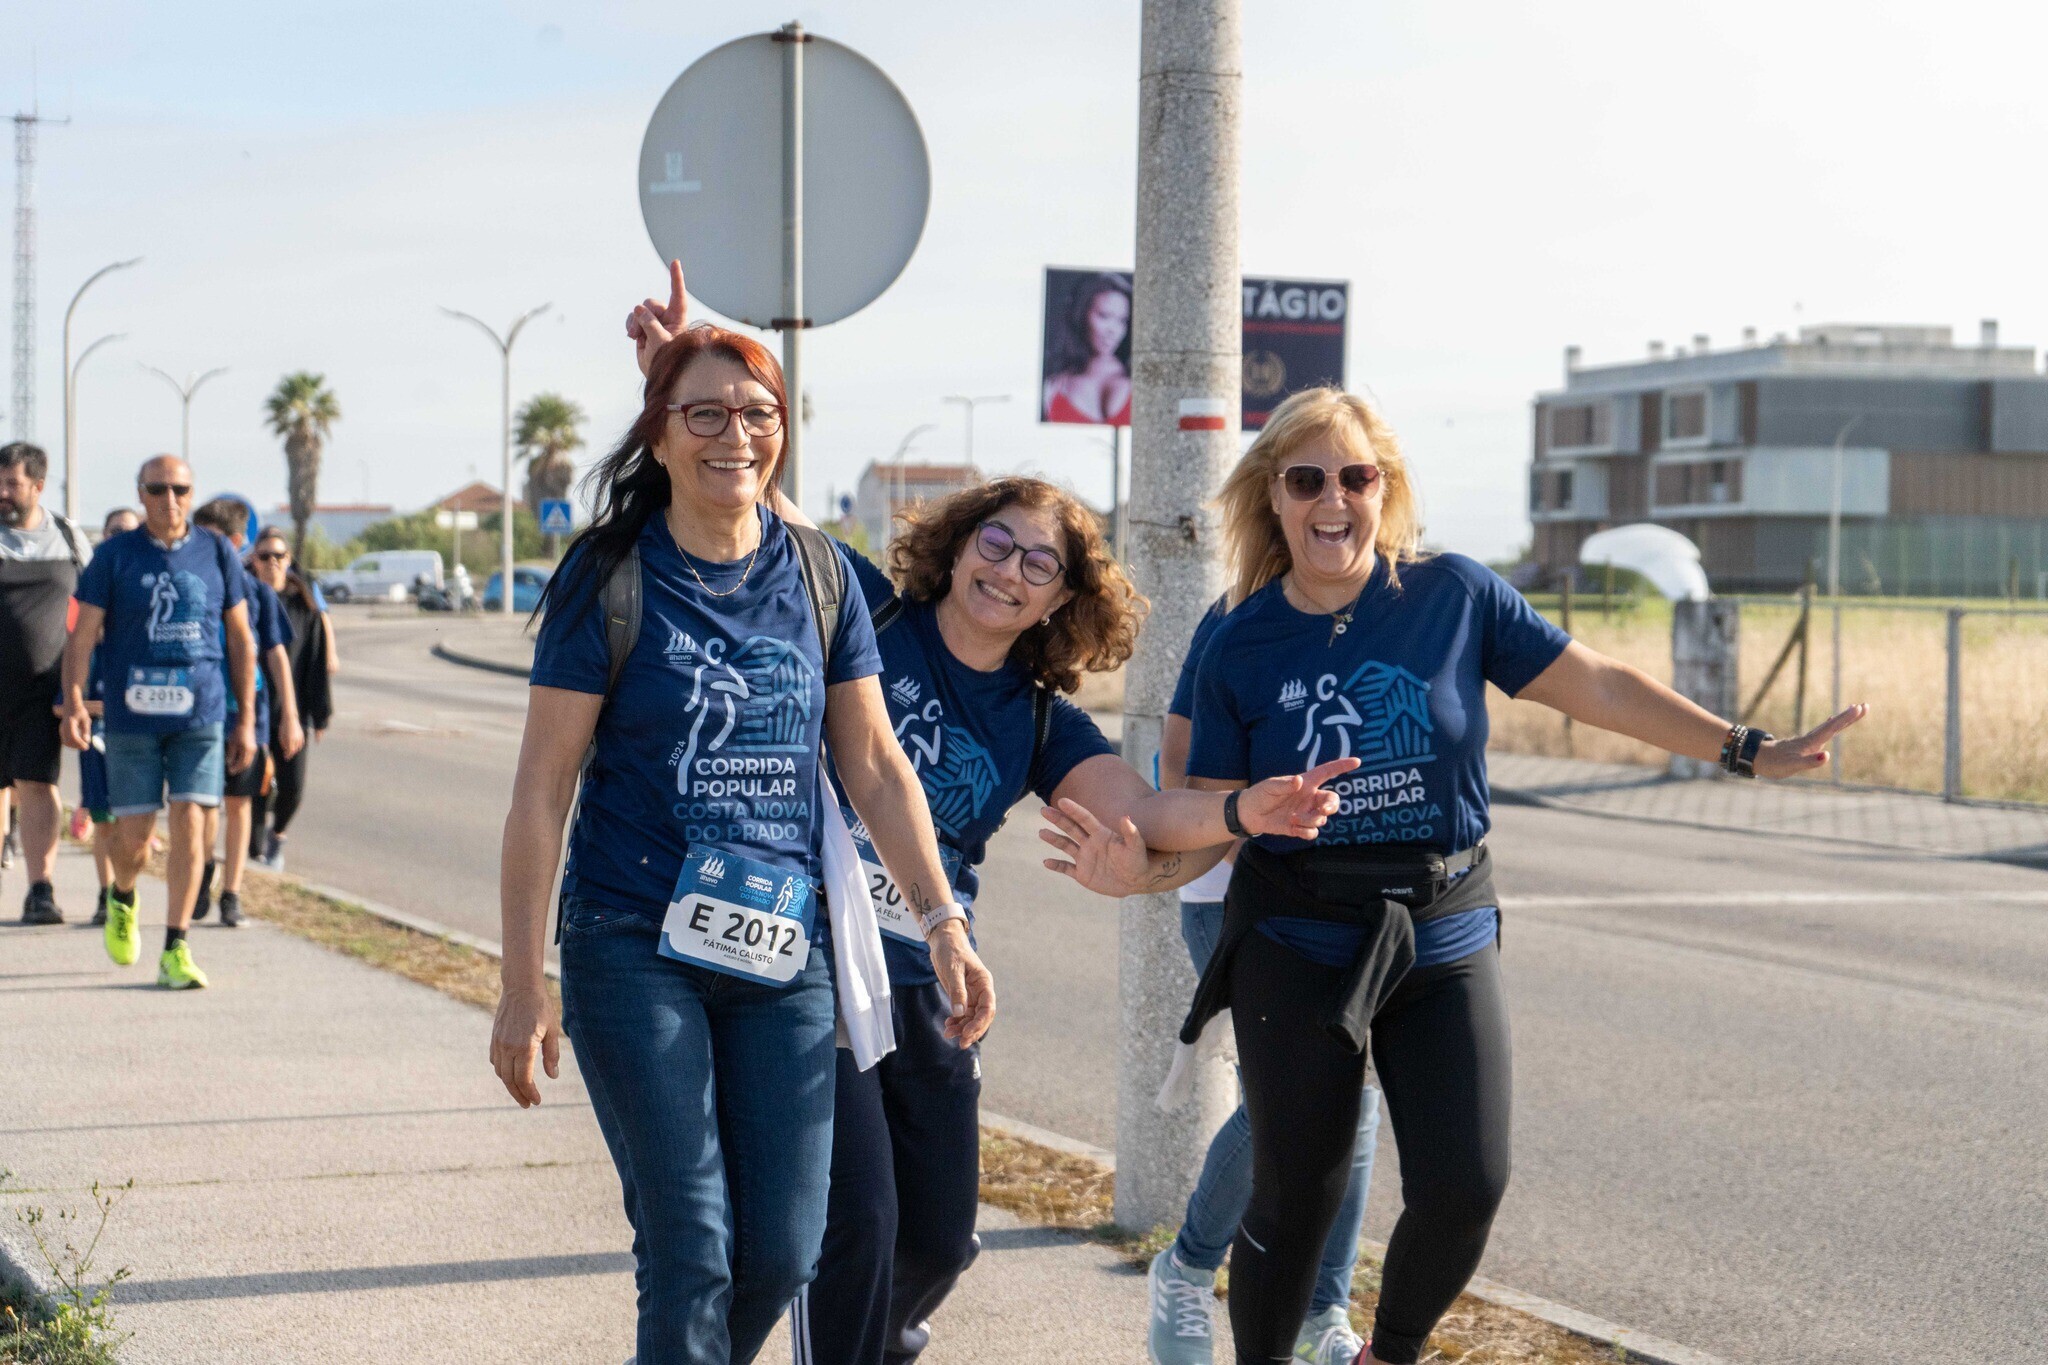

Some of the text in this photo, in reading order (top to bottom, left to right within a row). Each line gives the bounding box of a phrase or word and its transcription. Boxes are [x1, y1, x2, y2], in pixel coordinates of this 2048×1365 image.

[135, 688, 184, 701] E 2015
[668, 740, 686, 767] 2024
[695, 757, 796, 776] CORRIDA
[693, 779, 796, 798] POPULAR
[673, 801, 809, 820] COSTA NOVA
[1338, 786, 1425, 816] OPULAR
[1321, 803, 1442, 834] OSTA NOVA
[685, 823, 799, 842] DO PRADO
[1357, 824, 1434, 844] PRADO
[746, 881, 771, 891] POPULAR
[747, 875, 772, 885] CORRIDA
[739, 886, 757, 894] COSTA
[869, 873, 909, 912] 20
[751, 896, 770, 904] PRADO
[882, 907, 903, 921] FÉLIX
[688, 902, 797, 957] E 2012
[703, 938, 737, 955] FÁTIMA
[739, 949, 774, 964] CALISTO
